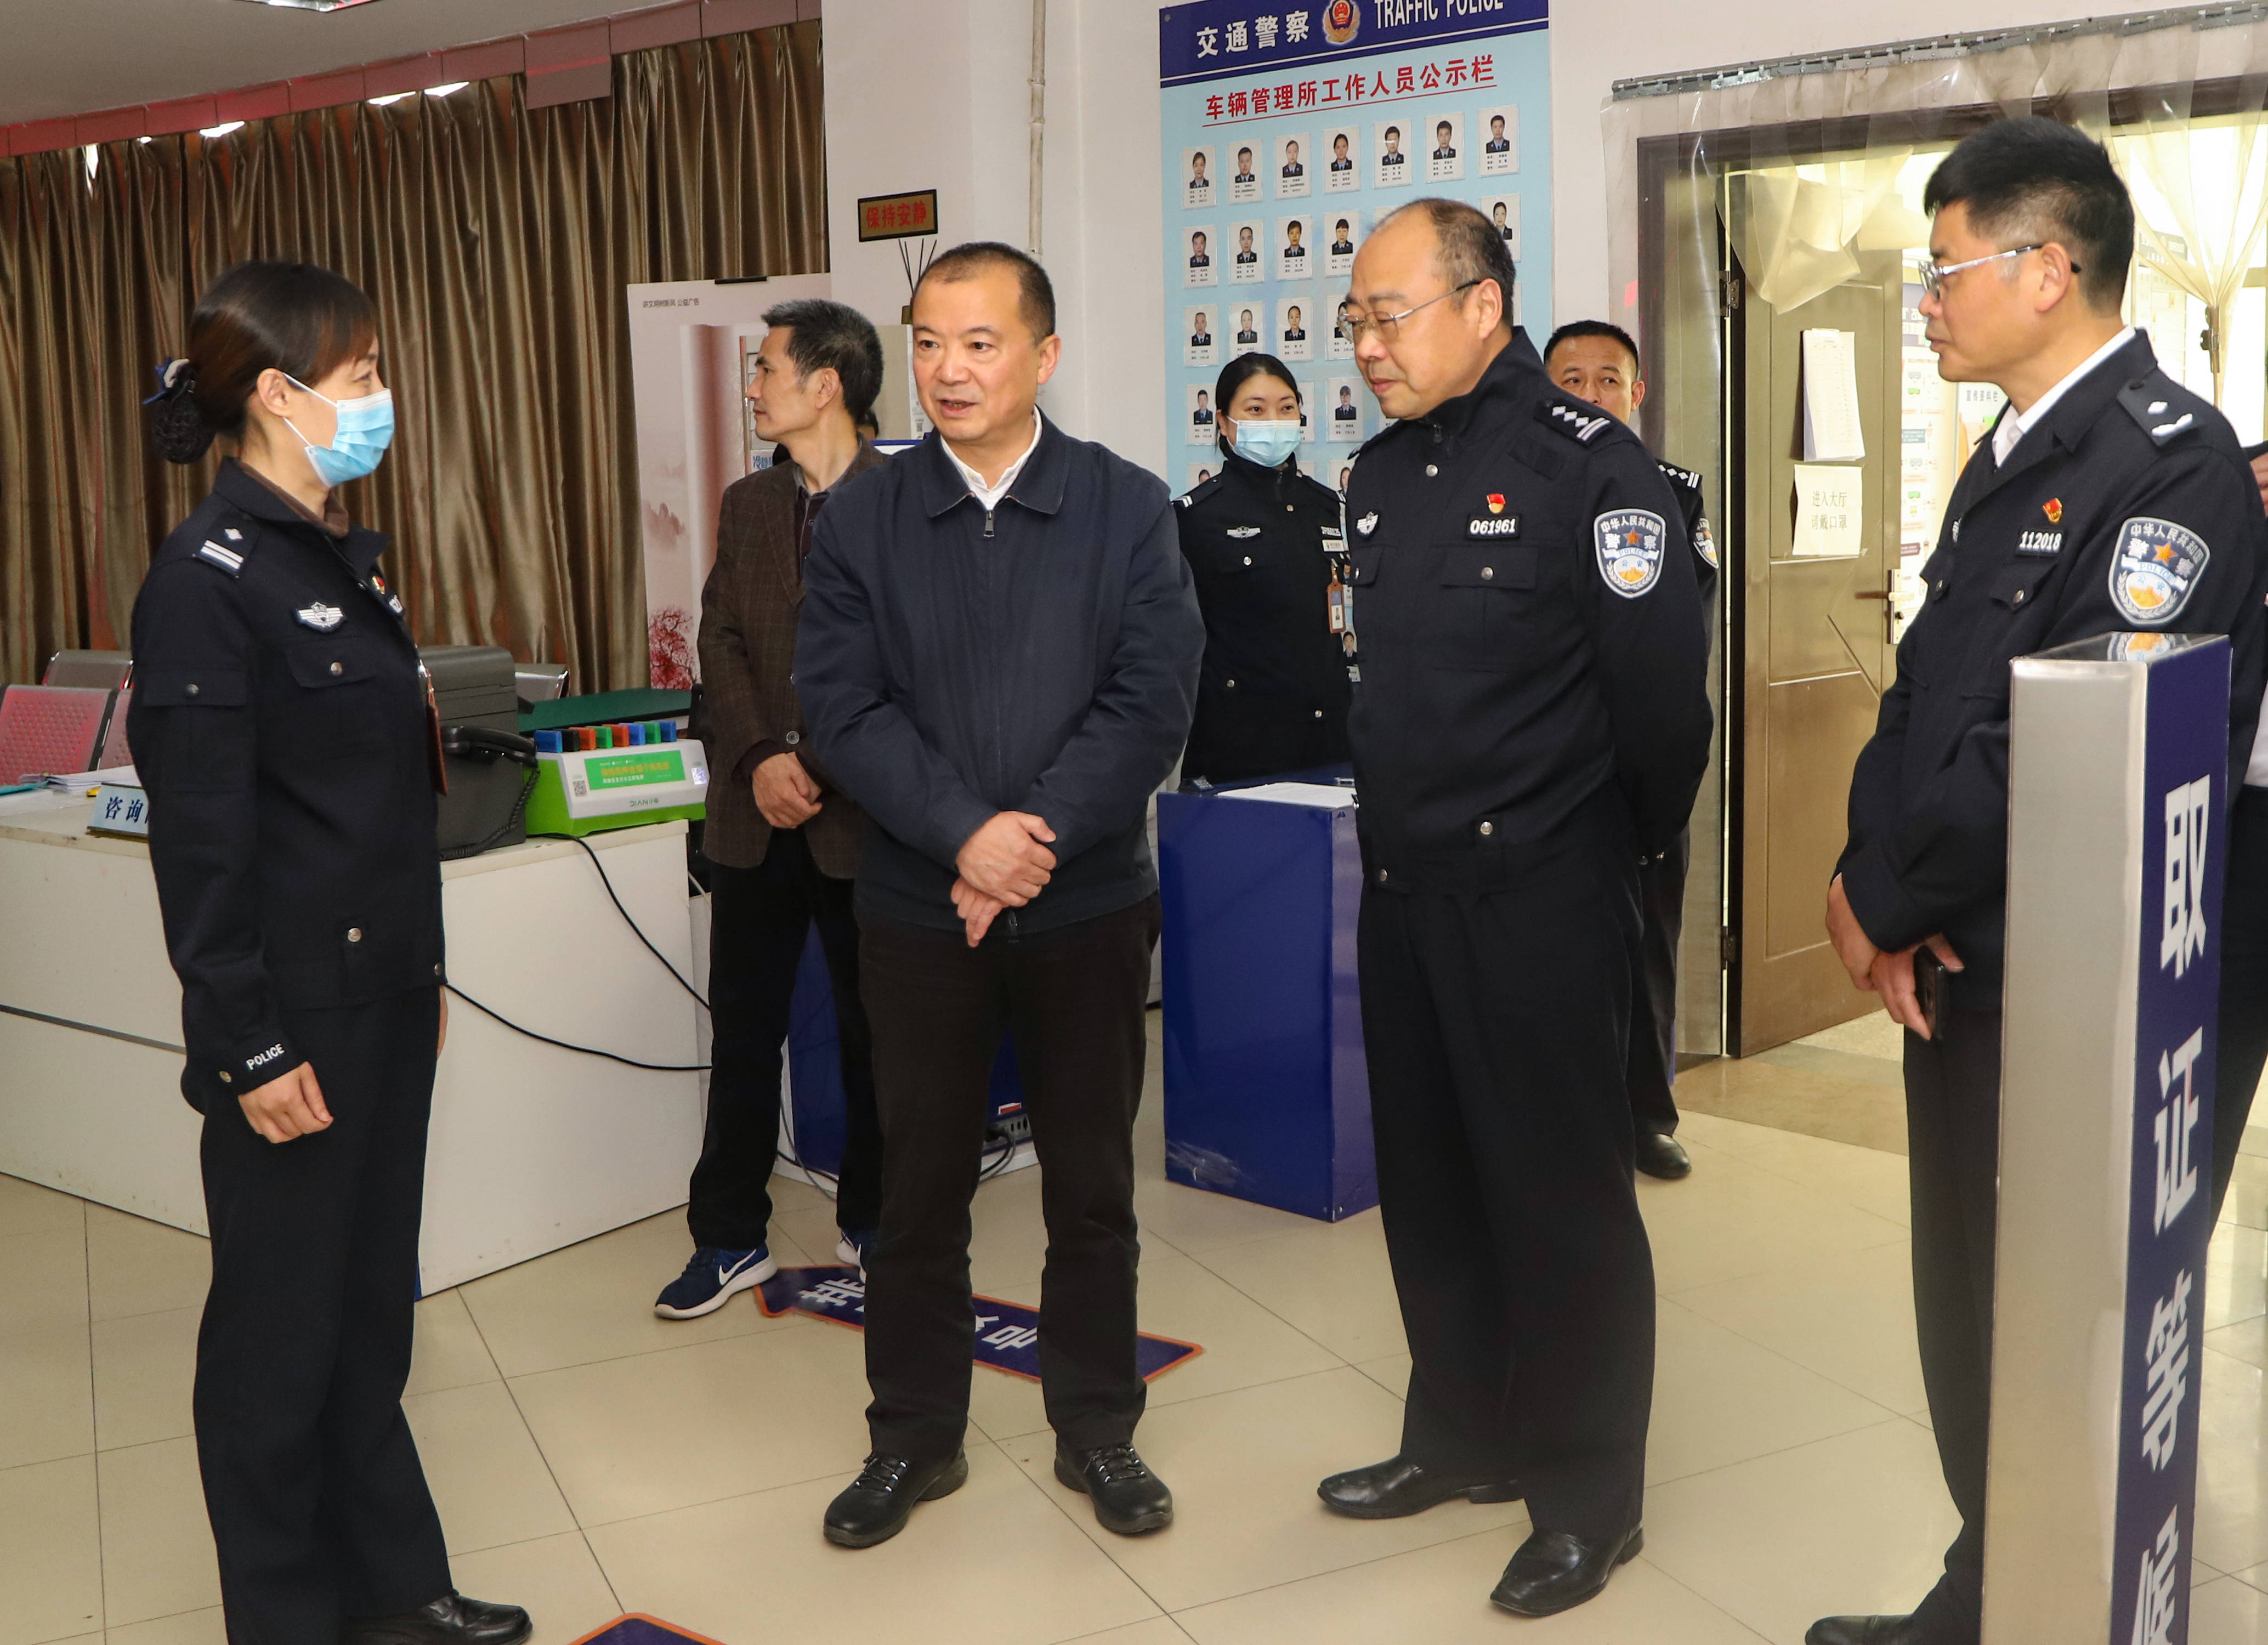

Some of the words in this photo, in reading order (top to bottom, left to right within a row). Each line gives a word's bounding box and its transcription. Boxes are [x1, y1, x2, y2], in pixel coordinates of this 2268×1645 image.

[1374, 0, 1438, 29] TRAFFIC
[1196, 10, 1309, 59] 交通警察
[1205, 54, 1495, 120] 车辆管理所工作人员公示栏
[865, 200, 927, 229] 保持安静
[1811, 490, 1847, 508] 进入大厅
[1469, 517, 1516, 536] 061961
[1600, 515, 1661, 536] 中华人民共和国
[1811, 513, 1848, 531] 请戴口罩
[1618, 548, 1647, 557] POLICE
[2018, 530, 2062, 551] 112018
[2130, 522, 2204, 564] 中华人民共和国
[2139, 563, 2175, 581] POLICE
[105, 795, 149, 824] 咨询
[246, 1043, 285, 1070] POLICE
